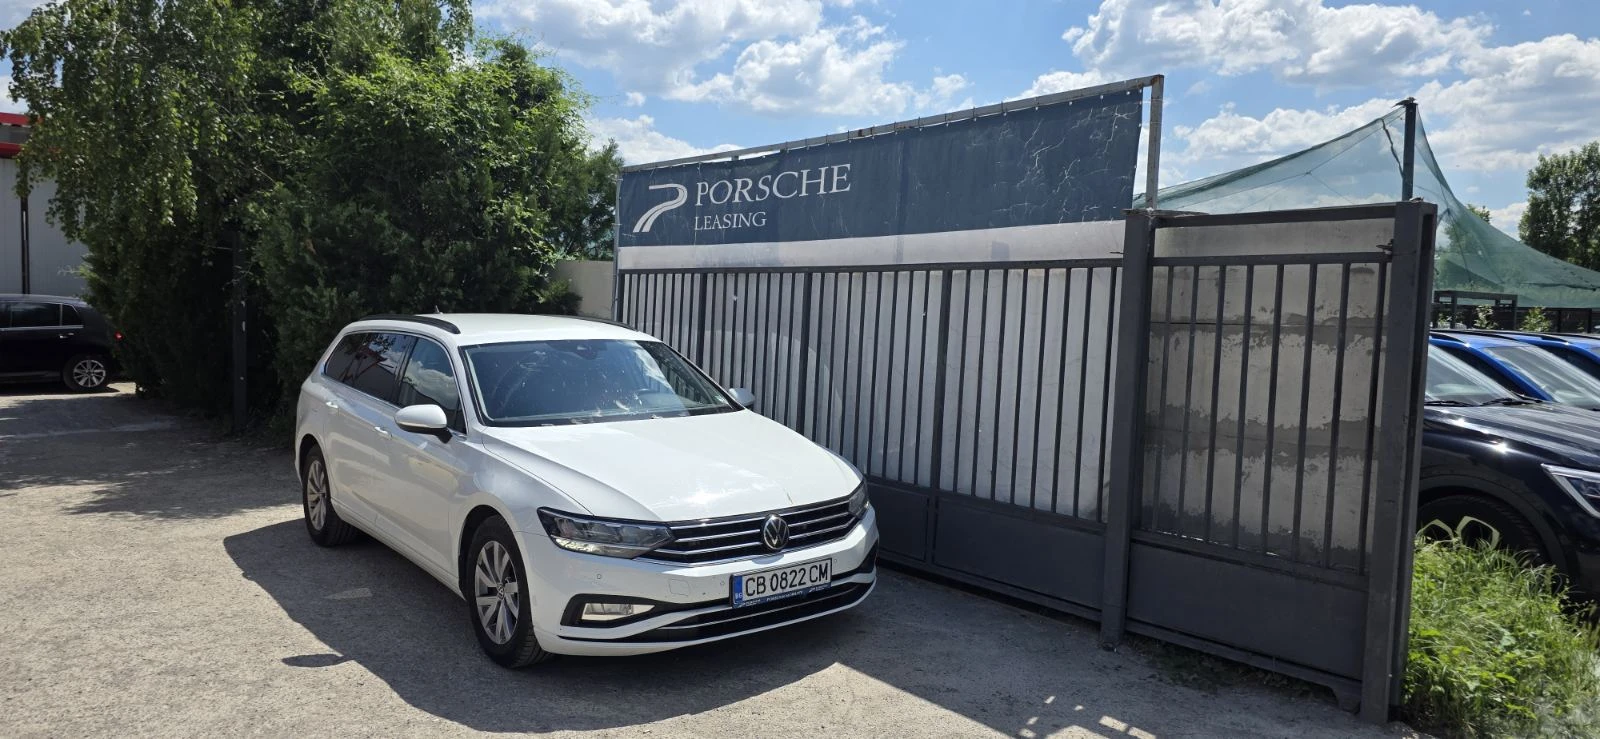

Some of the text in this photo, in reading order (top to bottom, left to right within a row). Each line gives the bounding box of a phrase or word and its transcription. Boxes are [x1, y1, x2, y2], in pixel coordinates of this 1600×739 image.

[695, 163, 851, 207] PORSCHE
[694, 211, 767, 231] LEASING
[745, 576, 767, 597] CB
[769, 567, 807, 592] 0822
[809, 562, 829, 583] CM
